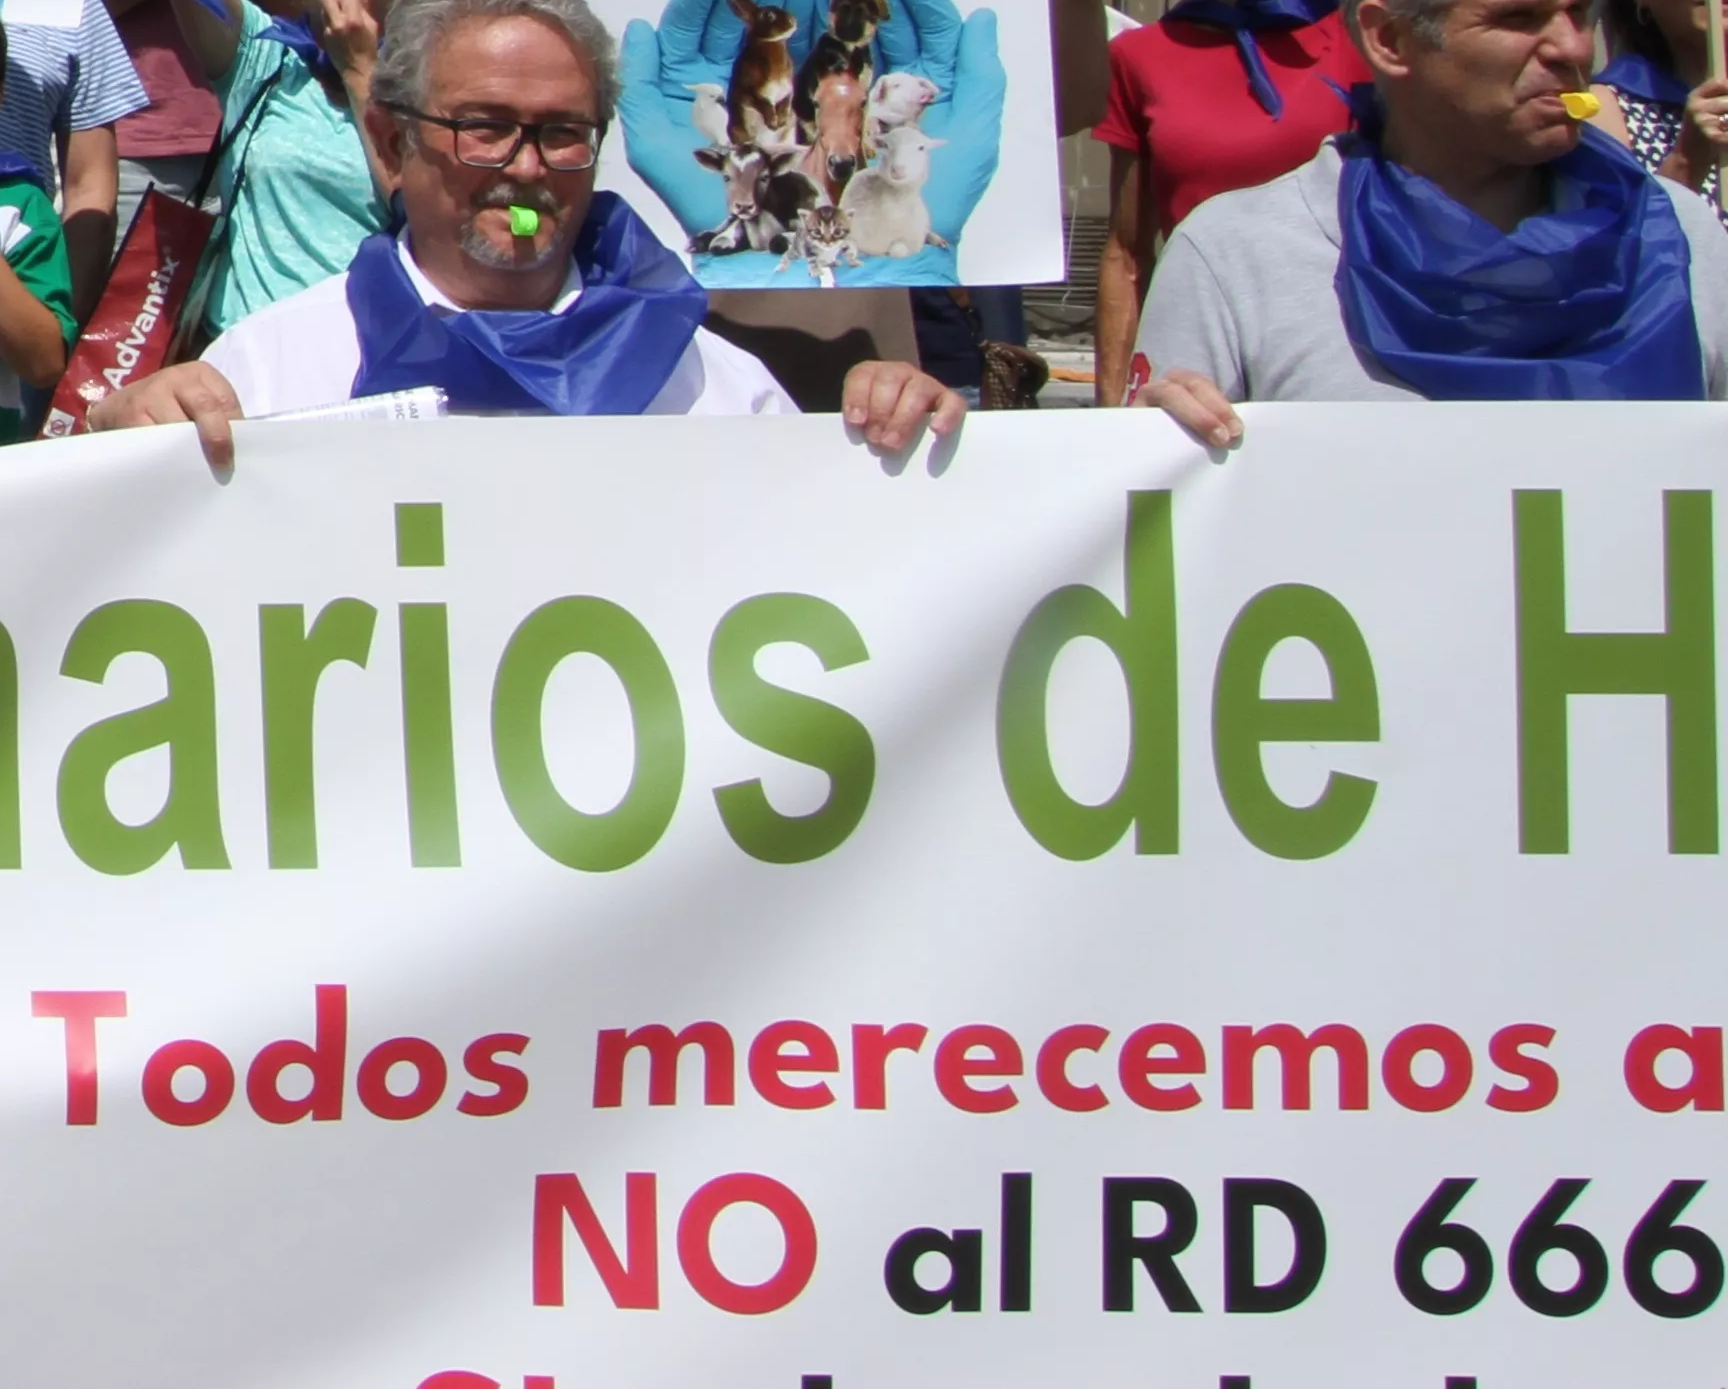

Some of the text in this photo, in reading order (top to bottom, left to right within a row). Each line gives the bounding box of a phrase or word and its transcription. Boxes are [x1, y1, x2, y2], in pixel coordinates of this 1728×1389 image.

[102, 258, 180, 391] Advantix
[996, 488, 1382, 862] de
[30, 984, 1725, 1129] Todos merecemos a
[532, 1171, 1725, 1322] NO al RD 666
